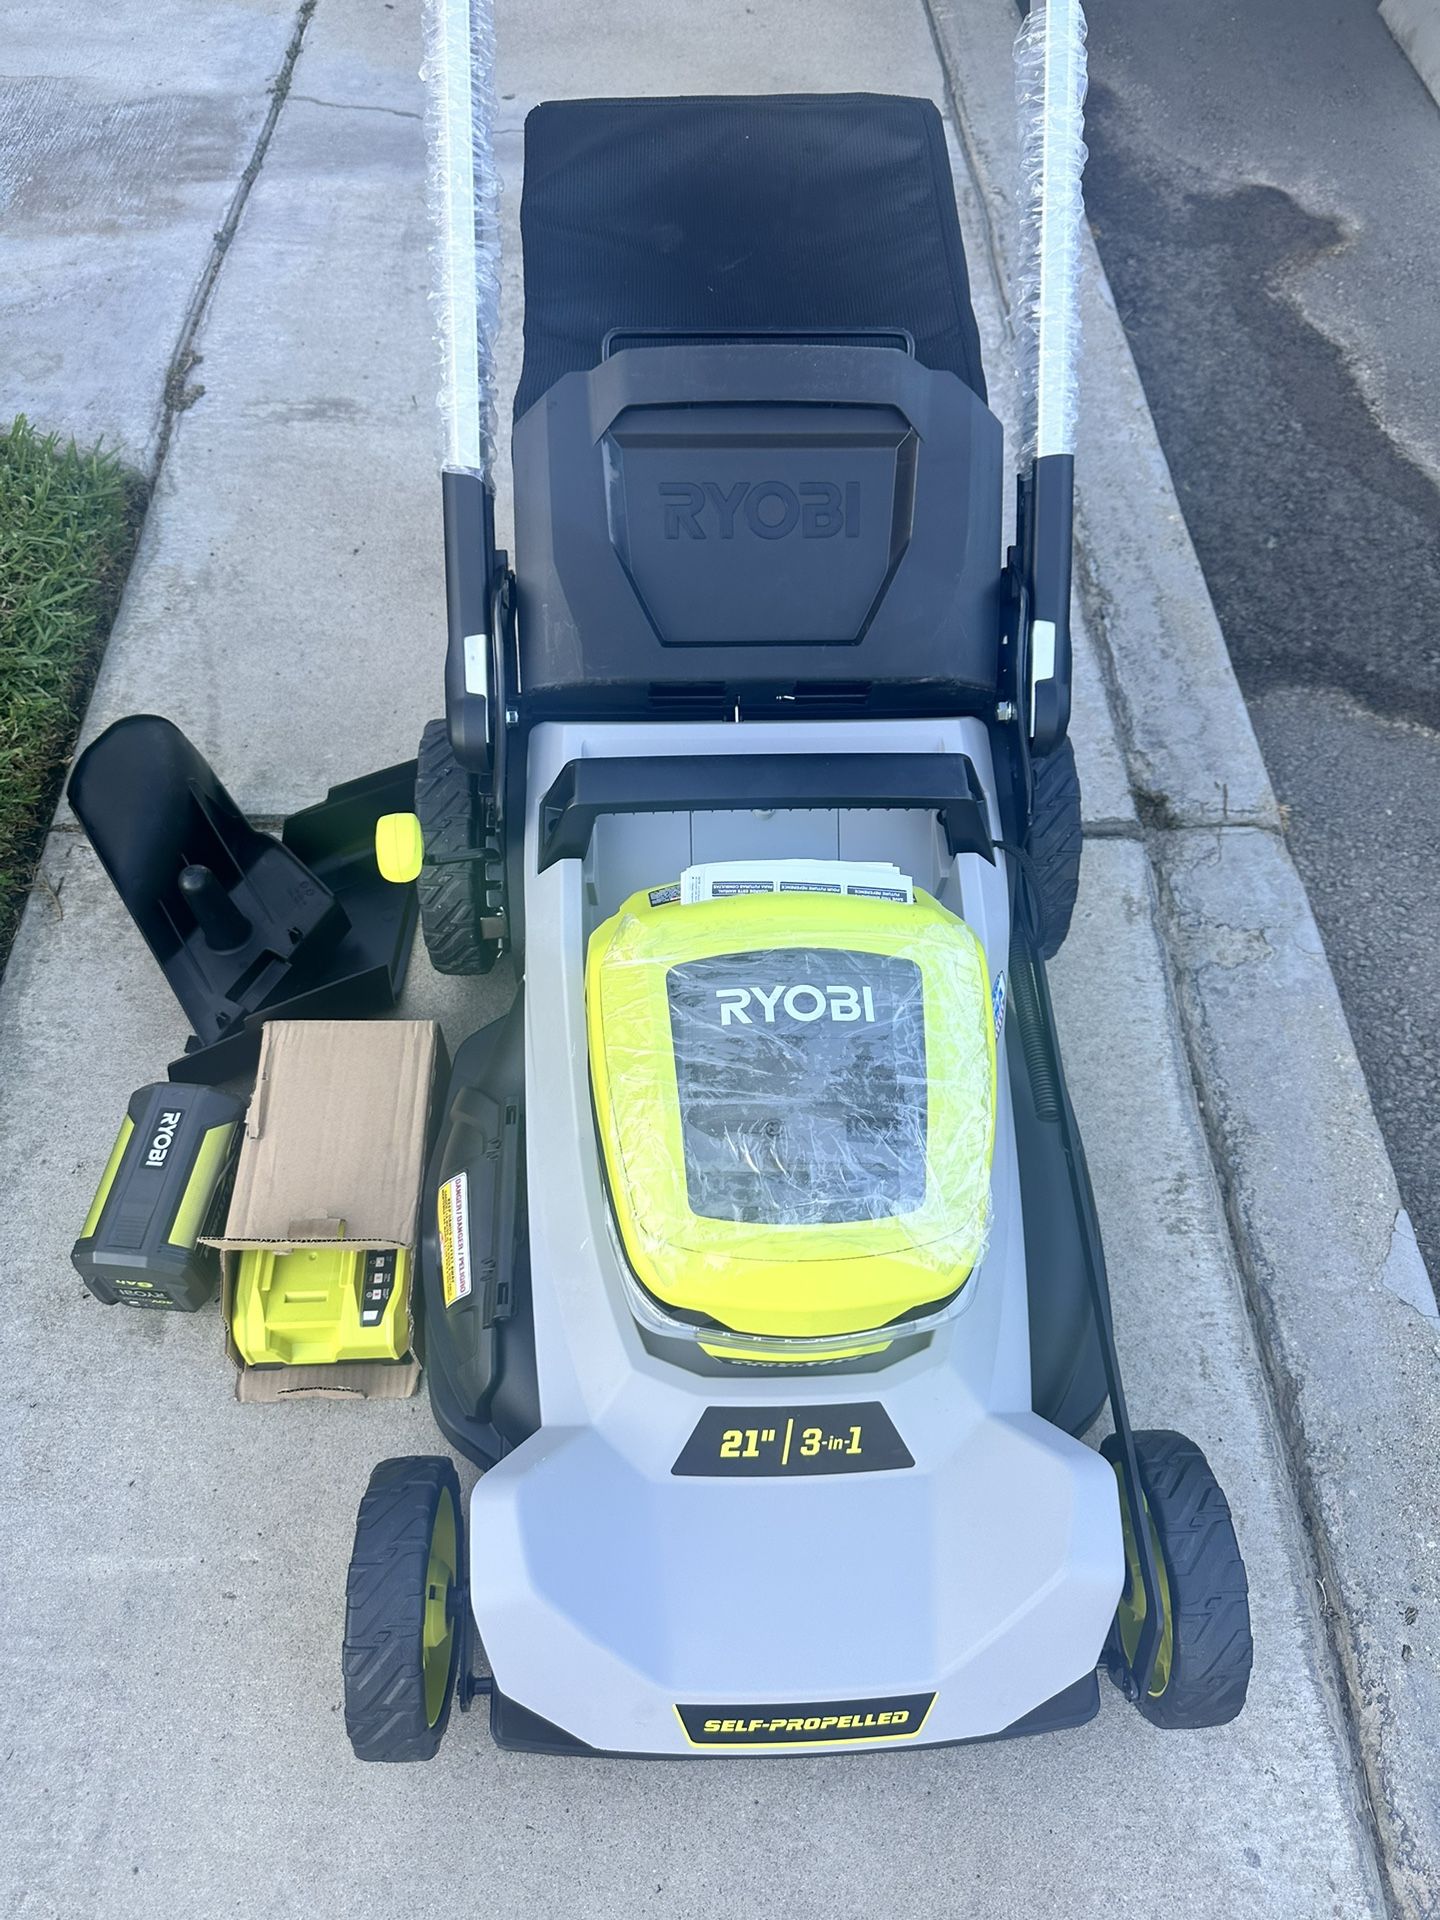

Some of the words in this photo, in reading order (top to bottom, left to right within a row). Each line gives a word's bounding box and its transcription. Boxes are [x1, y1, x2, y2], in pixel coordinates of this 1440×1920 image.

[658, 480, 861, 540] RYOBI
[716, 984, 876, 1026] RYOBI
[145, 1112, 182, 1167] RYOBI
[456, 1216, 464, 1250] DANGER
[458, 1257, 466, 1293] PELIGRO
[119, 1289, 168, 1299] RYOBI
[720, 1429, 776, 1458] 21"
[800, 1426, 862, 1456] 3-in-1
[703, 1710, 910, 1733] SELF-PROPELLED
